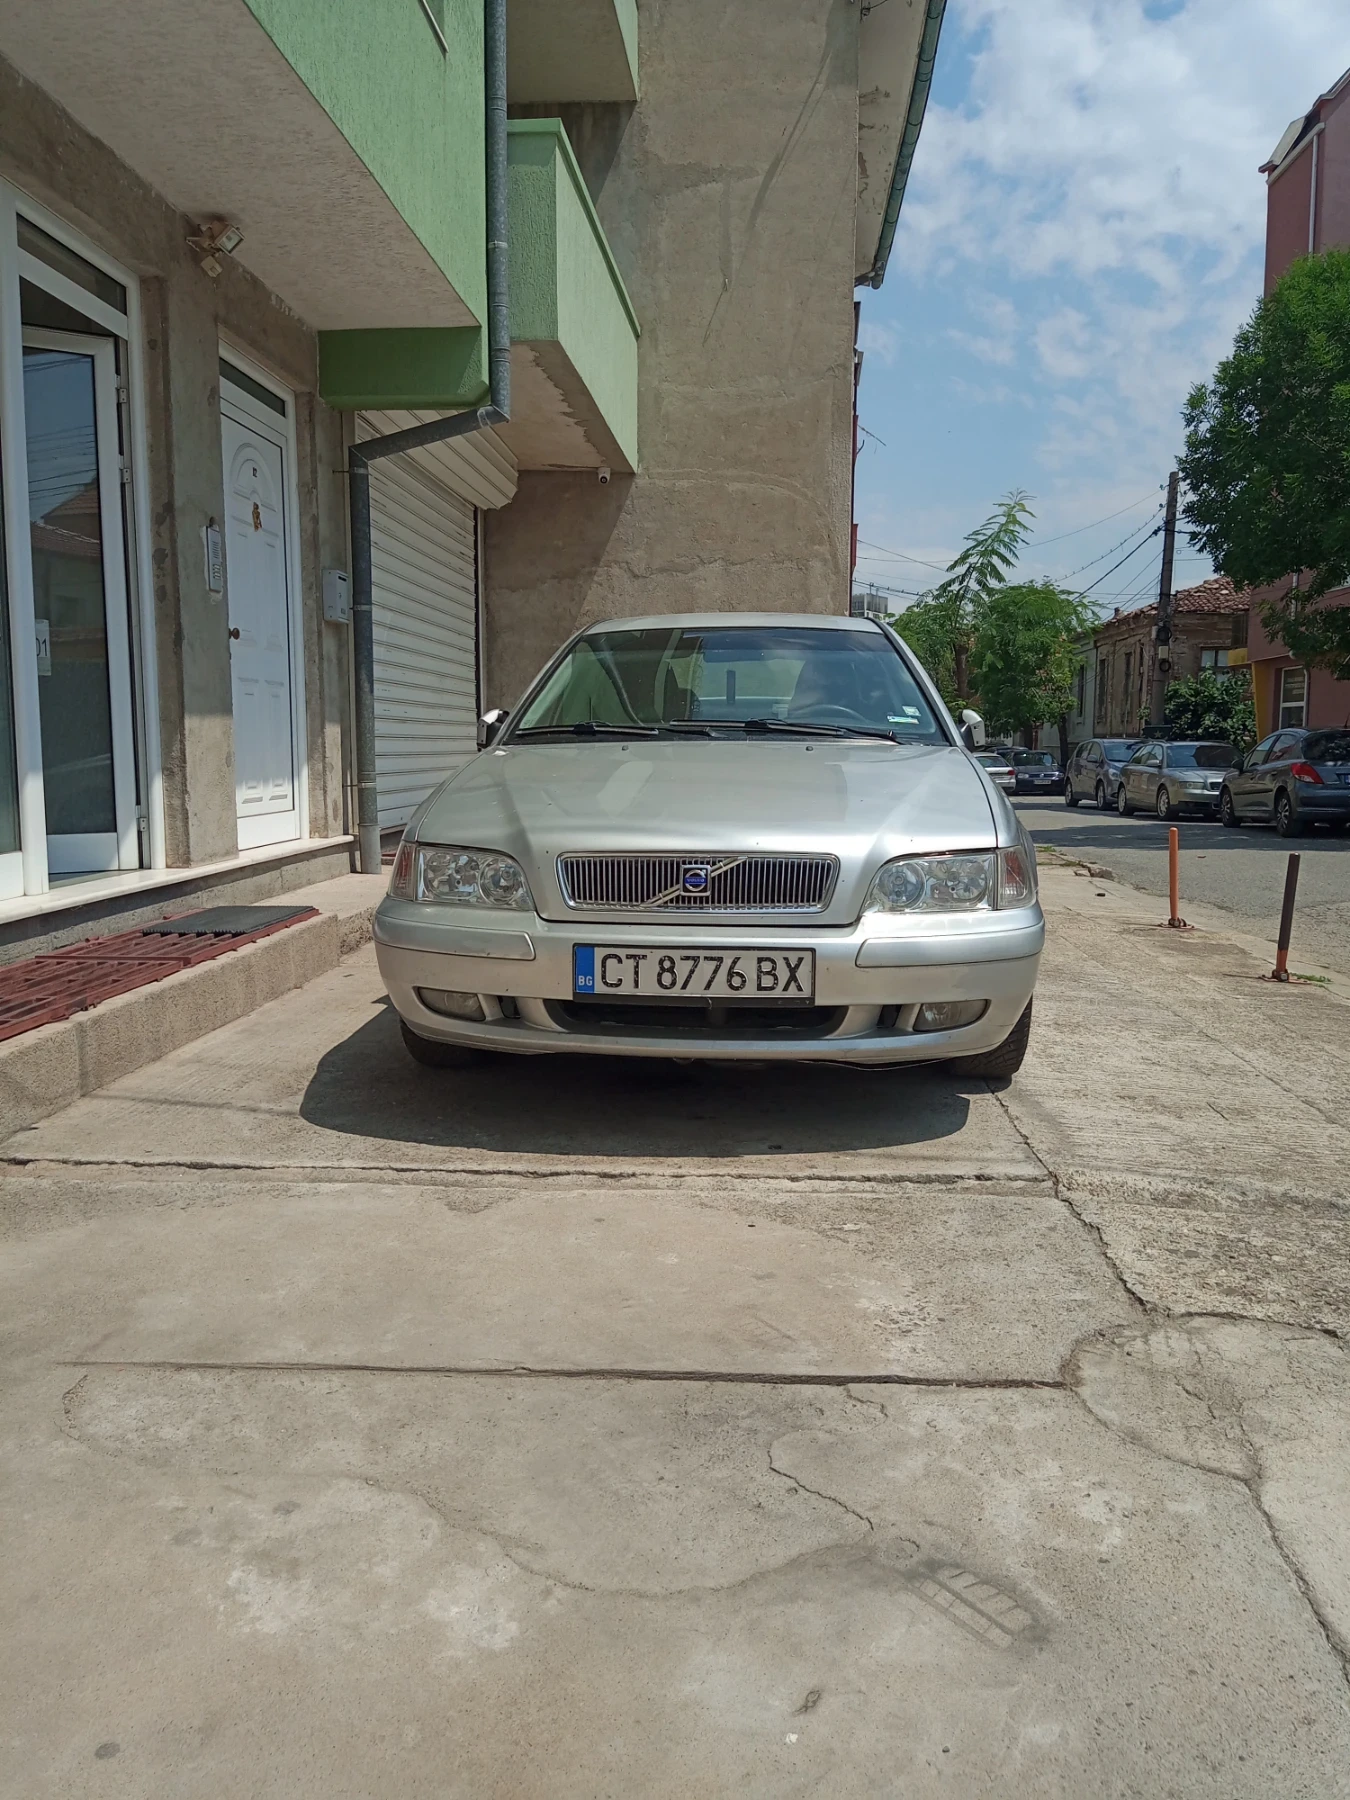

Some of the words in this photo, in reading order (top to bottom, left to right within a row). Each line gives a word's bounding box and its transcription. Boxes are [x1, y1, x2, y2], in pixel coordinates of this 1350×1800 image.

[578, 976, 593, 987] BG
[601, 953, 648, 989] CT
[656, 955, 747, 992] 8776
[756, 956, 805, 992] BX
